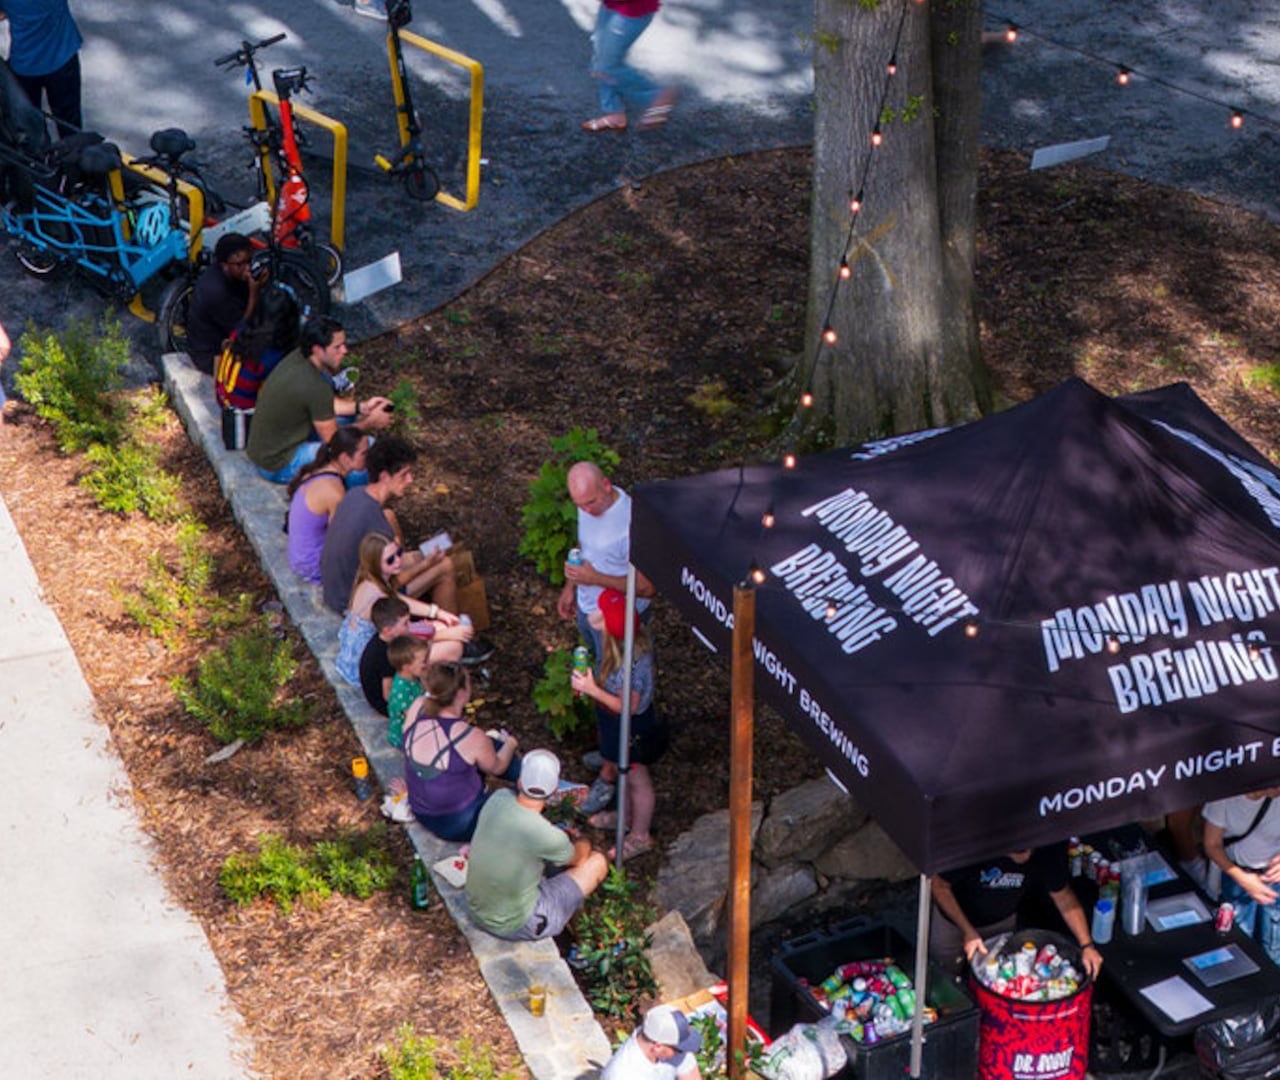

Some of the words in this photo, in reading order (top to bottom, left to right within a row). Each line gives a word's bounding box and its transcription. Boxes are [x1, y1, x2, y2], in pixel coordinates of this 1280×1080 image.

[769, 543, 898, 654] BREWING
[800, 487, 920, 577] MONDAY
[882, 553, 980, 637] NIGHT
[682, 567, 735, 630] MONDA
[799, 688, 869, 777] BREWING
[1040, 580, 1189, 673] MONDAY
[1107, 630, 1280, 714] BREWING
[1039, 765, 1167, 816] MONDAY
[1175, 741, 1264, 780] NIGHT
